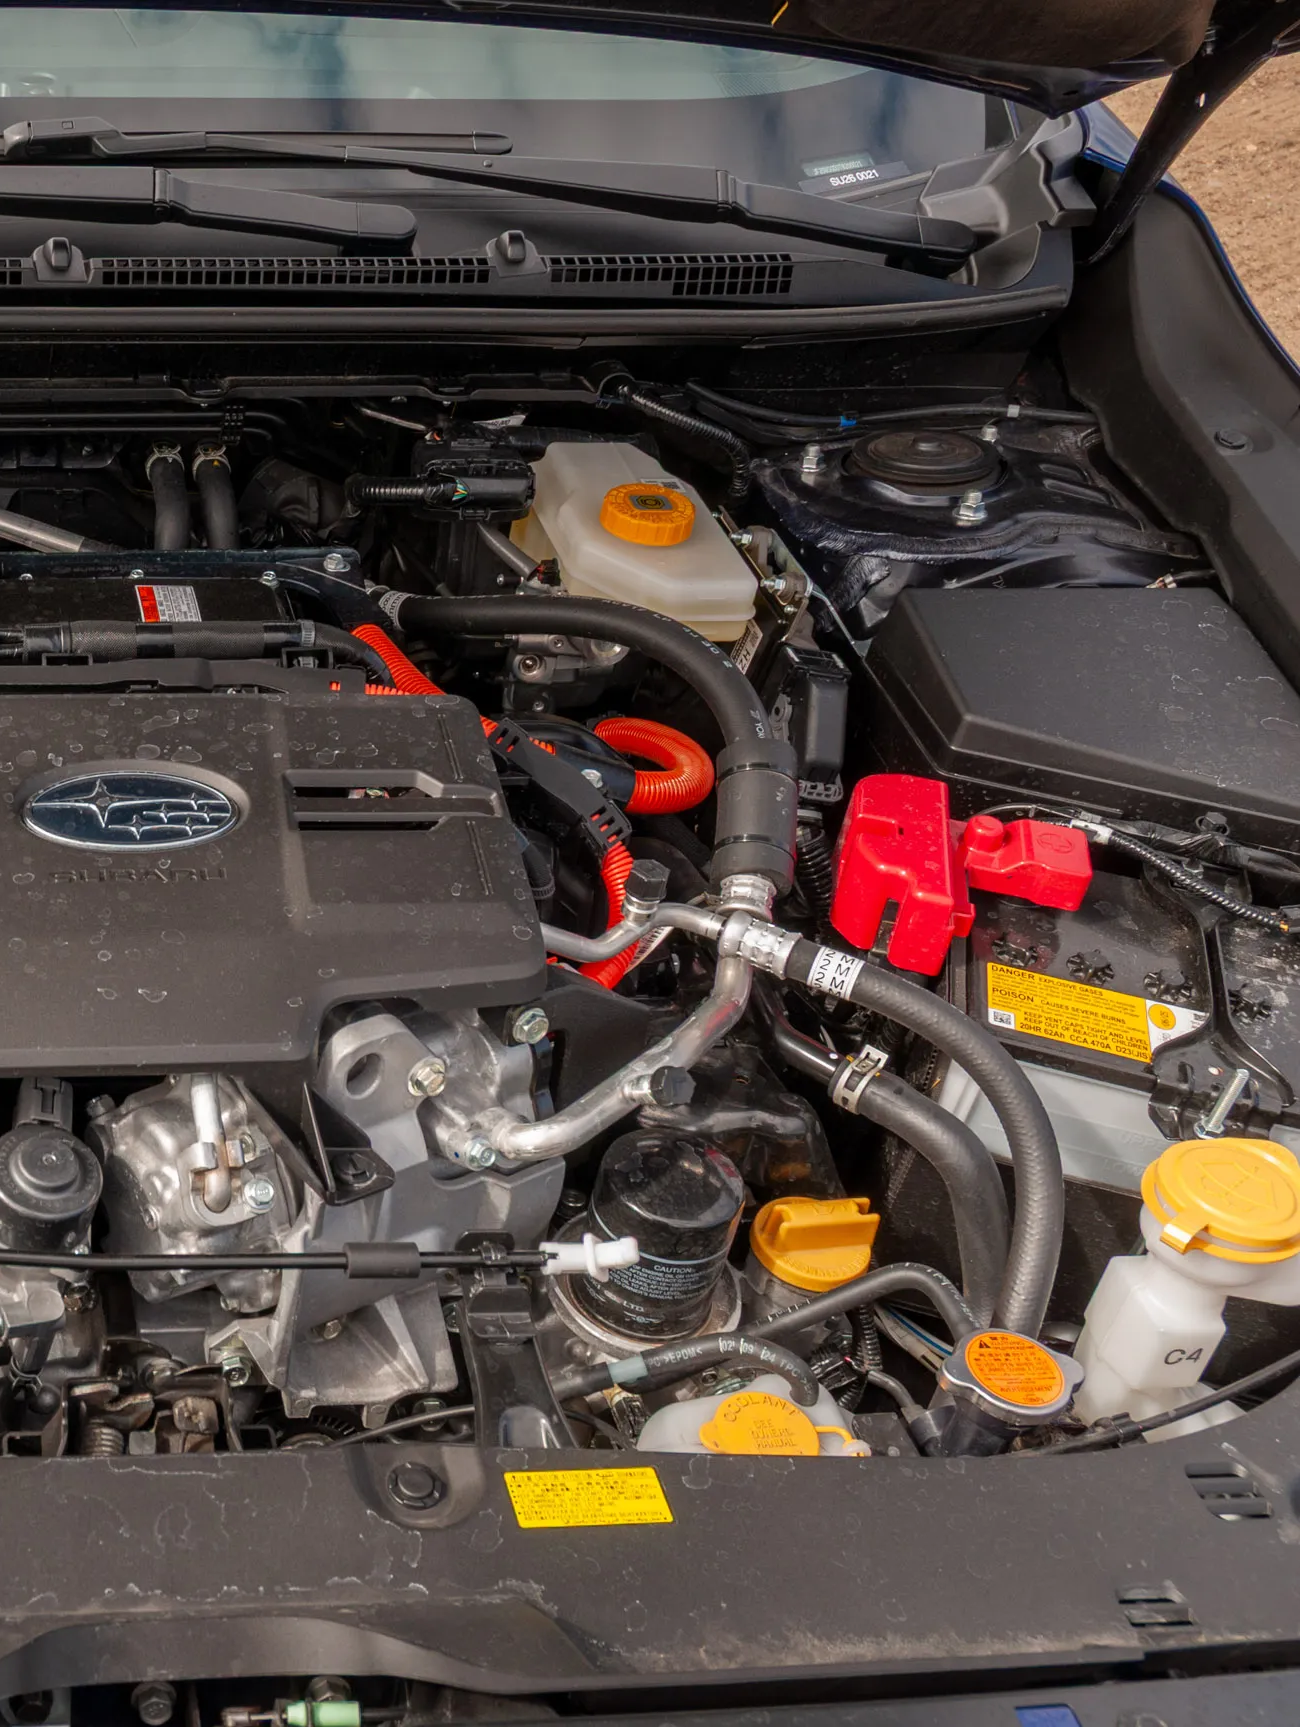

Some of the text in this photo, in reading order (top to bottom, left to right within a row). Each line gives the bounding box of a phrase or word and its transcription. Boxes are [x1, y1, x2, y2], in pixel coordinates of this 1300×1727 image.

[829, 173, 857, 187] SU26
[855, 168, 880, 182] 0021
[50, 868, 227, 883] SUBARU
[991, 964, 1034, 980] DANGER
[1038, 976, 1076, 990] EXPLOSIVE
[1079, 986, 1102, 996] GASES
[992, 987, 1125, 1024] POISON CAUSES SEVERE BURNS
[1020, 1022, 1041, 1032] 20HR
[1043, 1028, 1064, 1038] 62Ah
[1069, 1034, 1088, 1044] CCA
[1090, 1039, 1111, 1050] 470A
[1024, 1011, 1042, 1019] KEEP
[1044, 1015, 1061, 1024] VENT
[1064, 1020, 1084, 1029] CAPS
[1086, 1025, 1106, 1035] TIGHT
[1108, 1031, 1123, 1039] AND
[1125, 1035, 1147, 1045] LEVEL
[1024, 1016, 1042, 1025] KEEP
[1044, 1021, 1058, 1029] OUT
[1073, 1028, 1097, 1038] REACH
[1111, 1037, 1147, 1051] CHILDREN
[654, 1265, 692, 1273] CAUTION
[1164, 1347, 1203, 1365] C4
[723, 1395, 801, 1422] COOLANT
